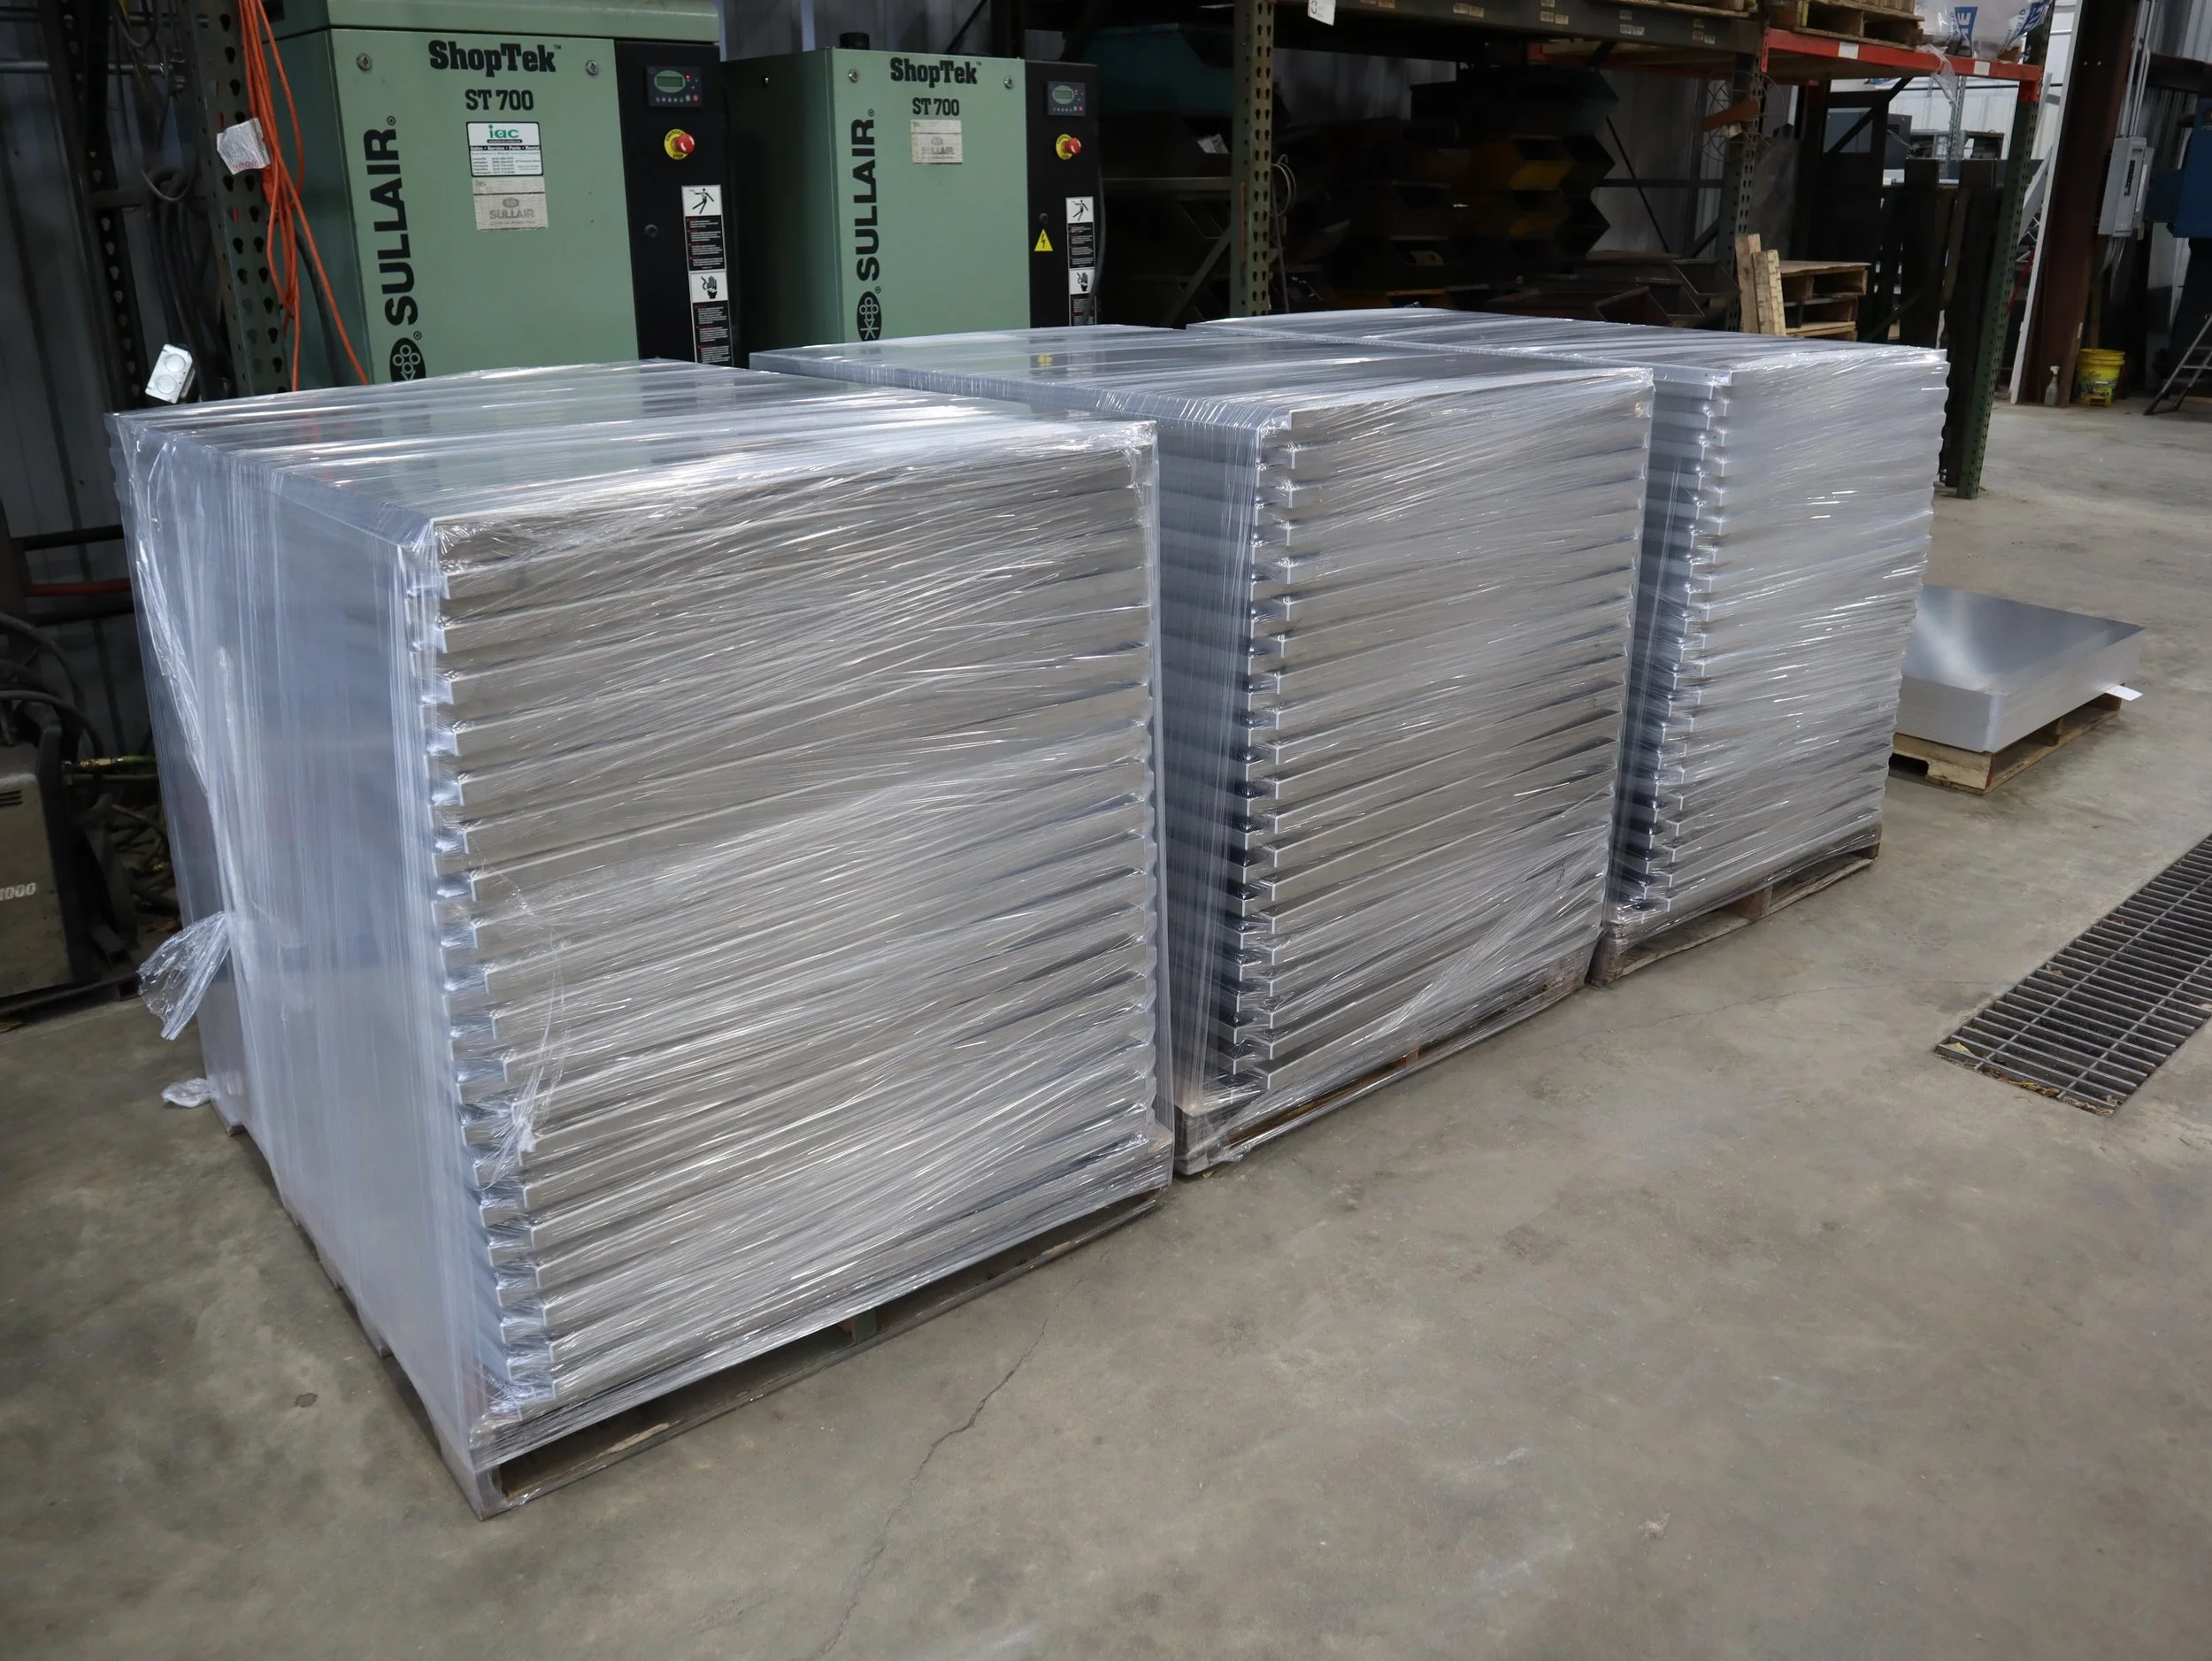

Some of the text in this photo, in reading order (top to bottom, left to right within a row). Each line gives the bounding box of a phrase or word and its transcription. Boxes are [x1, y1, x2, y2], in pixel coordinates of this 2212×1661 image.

[465, 88, 534, 111] ST 700
[912, 97, 960, 116] ST 700
[488, 124, 519, 138] iac
